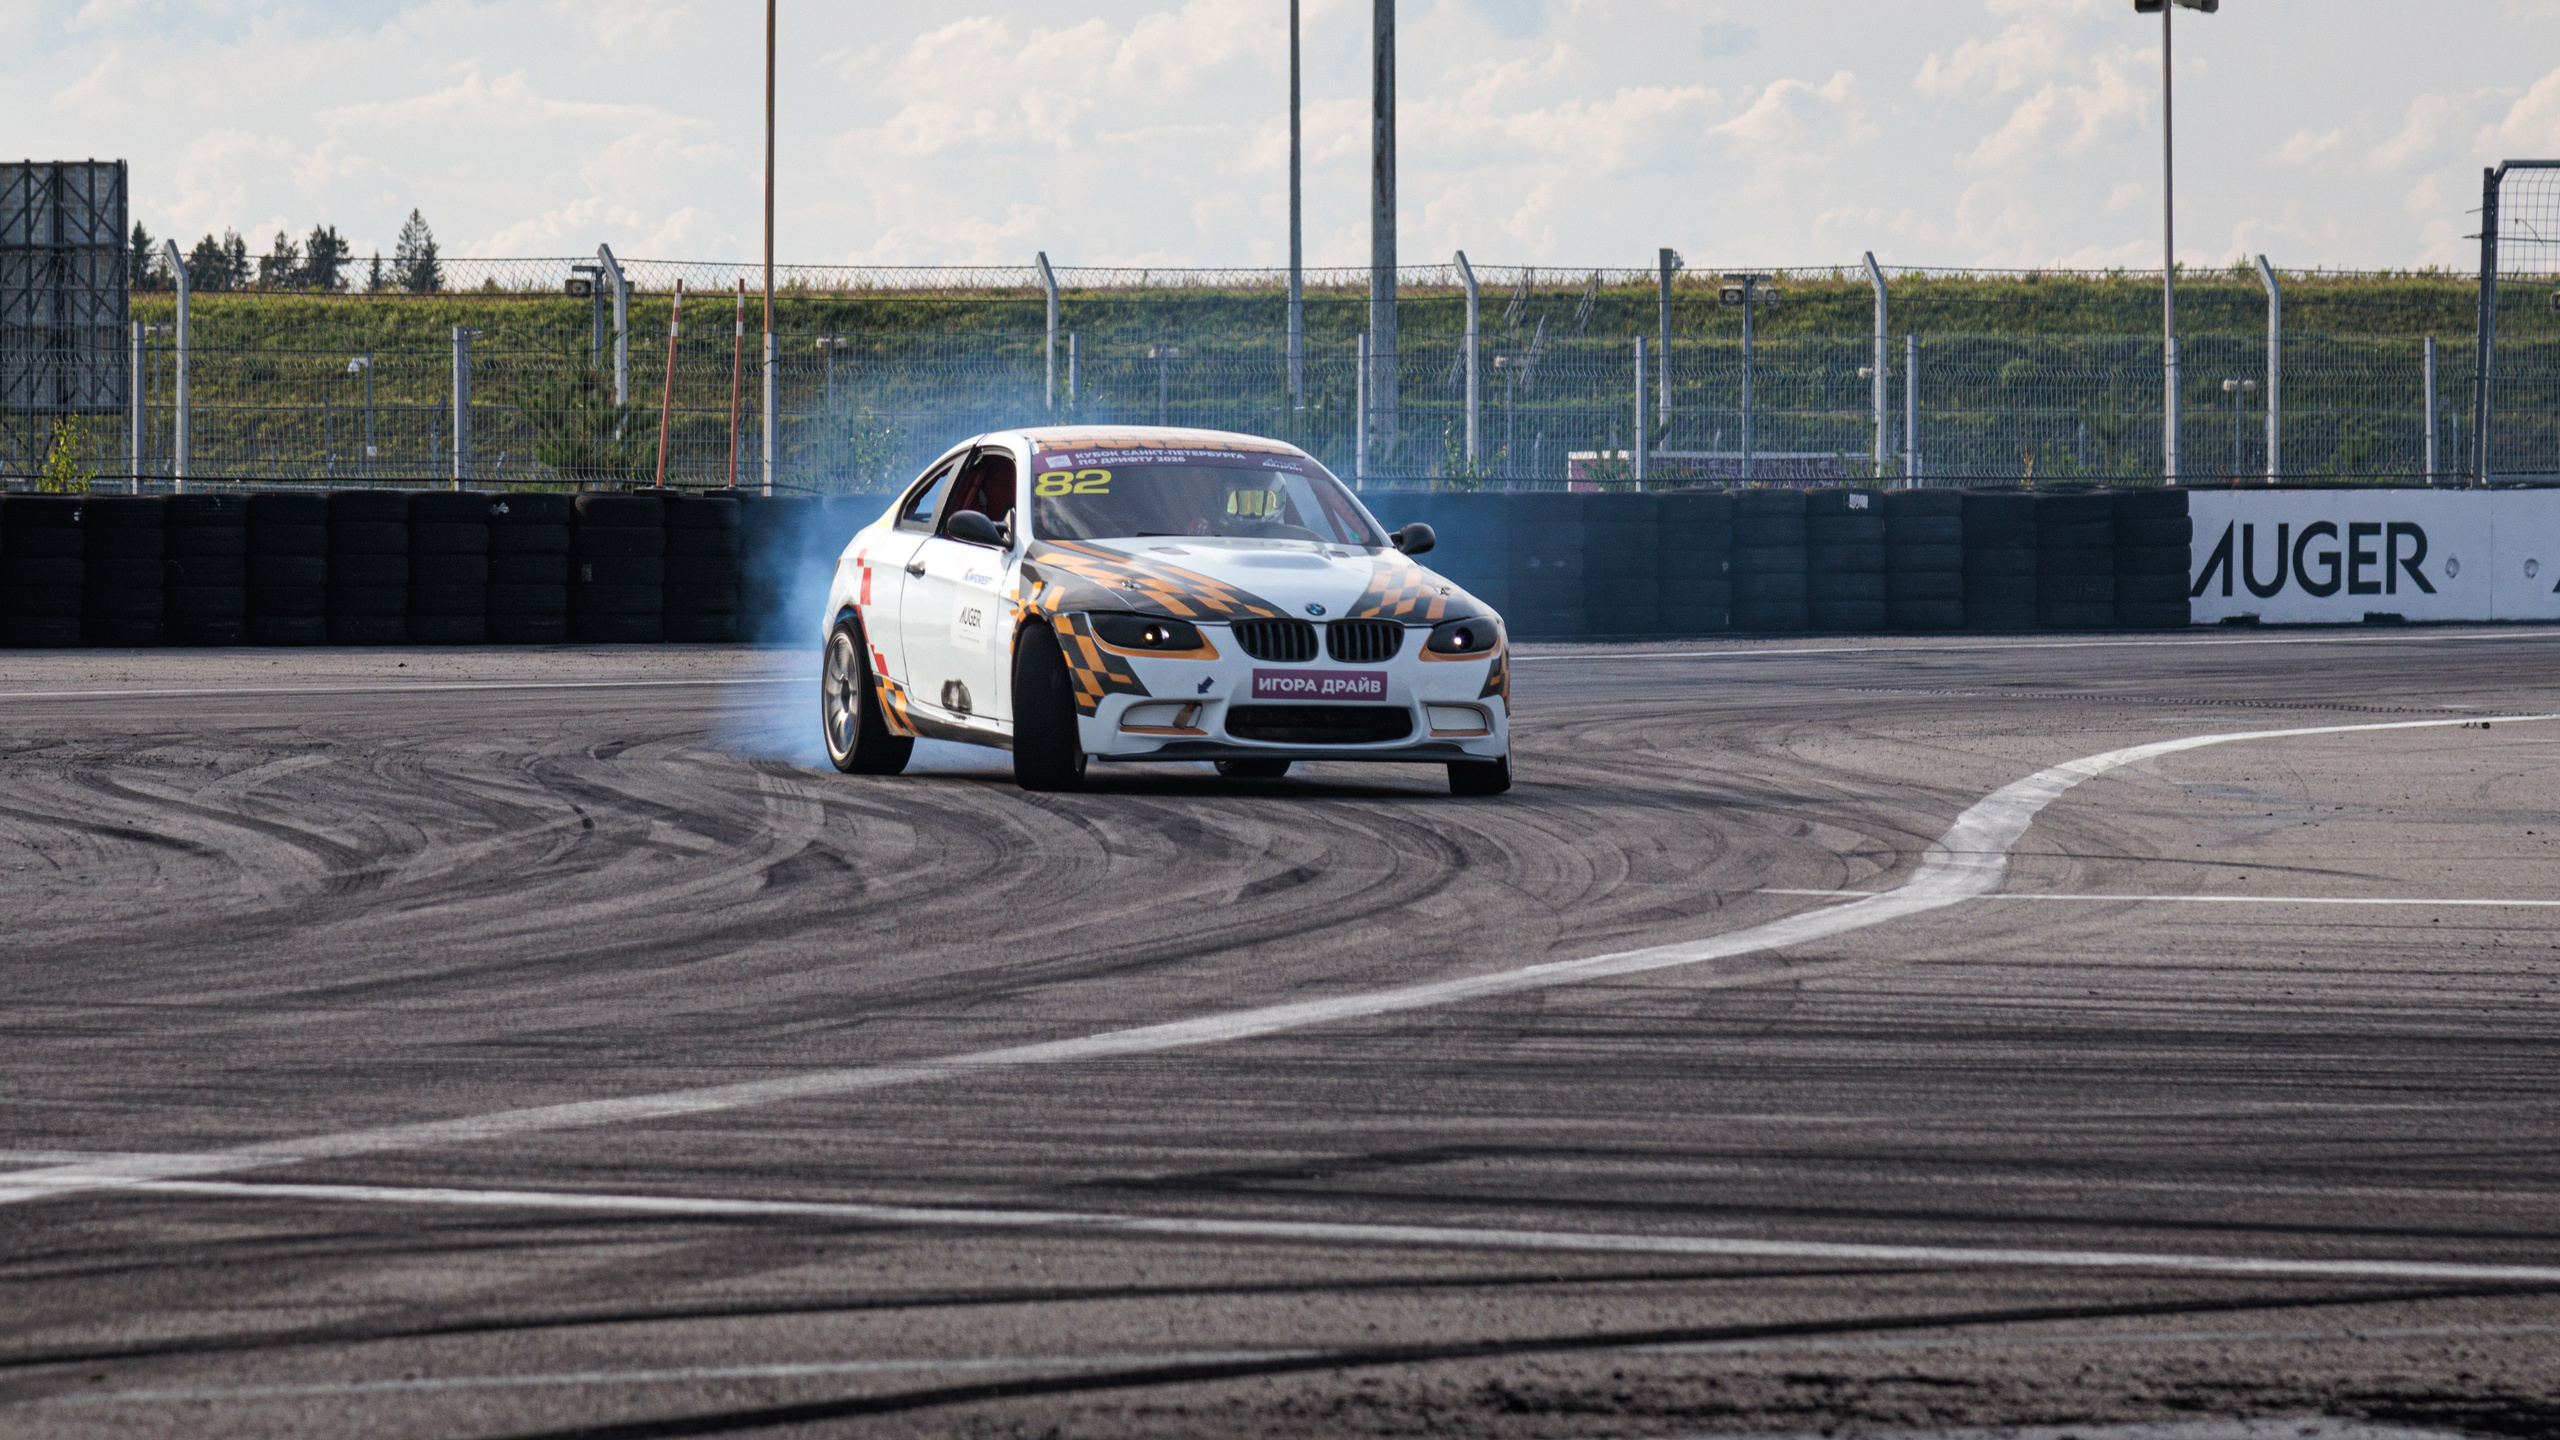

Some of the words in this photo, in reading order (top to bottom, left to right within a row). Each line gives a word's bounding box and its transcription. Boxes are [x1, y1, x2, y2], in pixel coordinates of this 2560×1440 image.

[1075, 450, 1119, 459] КУБОК
[1122, 449, 1246, 459] САНКТ-ПЕТЕРБУРГА
[1101, 456, 1153, 464] ДРИФТУ
[1034, 469, 1112, 497] 82
[2190, 519, 2438, 598] AUGER
[959, 606, 982, 628] AUGER
[1259, 677, 1317, 692] ИГОРА
[1321, 676, 1382, 694] ДРАЙВ
